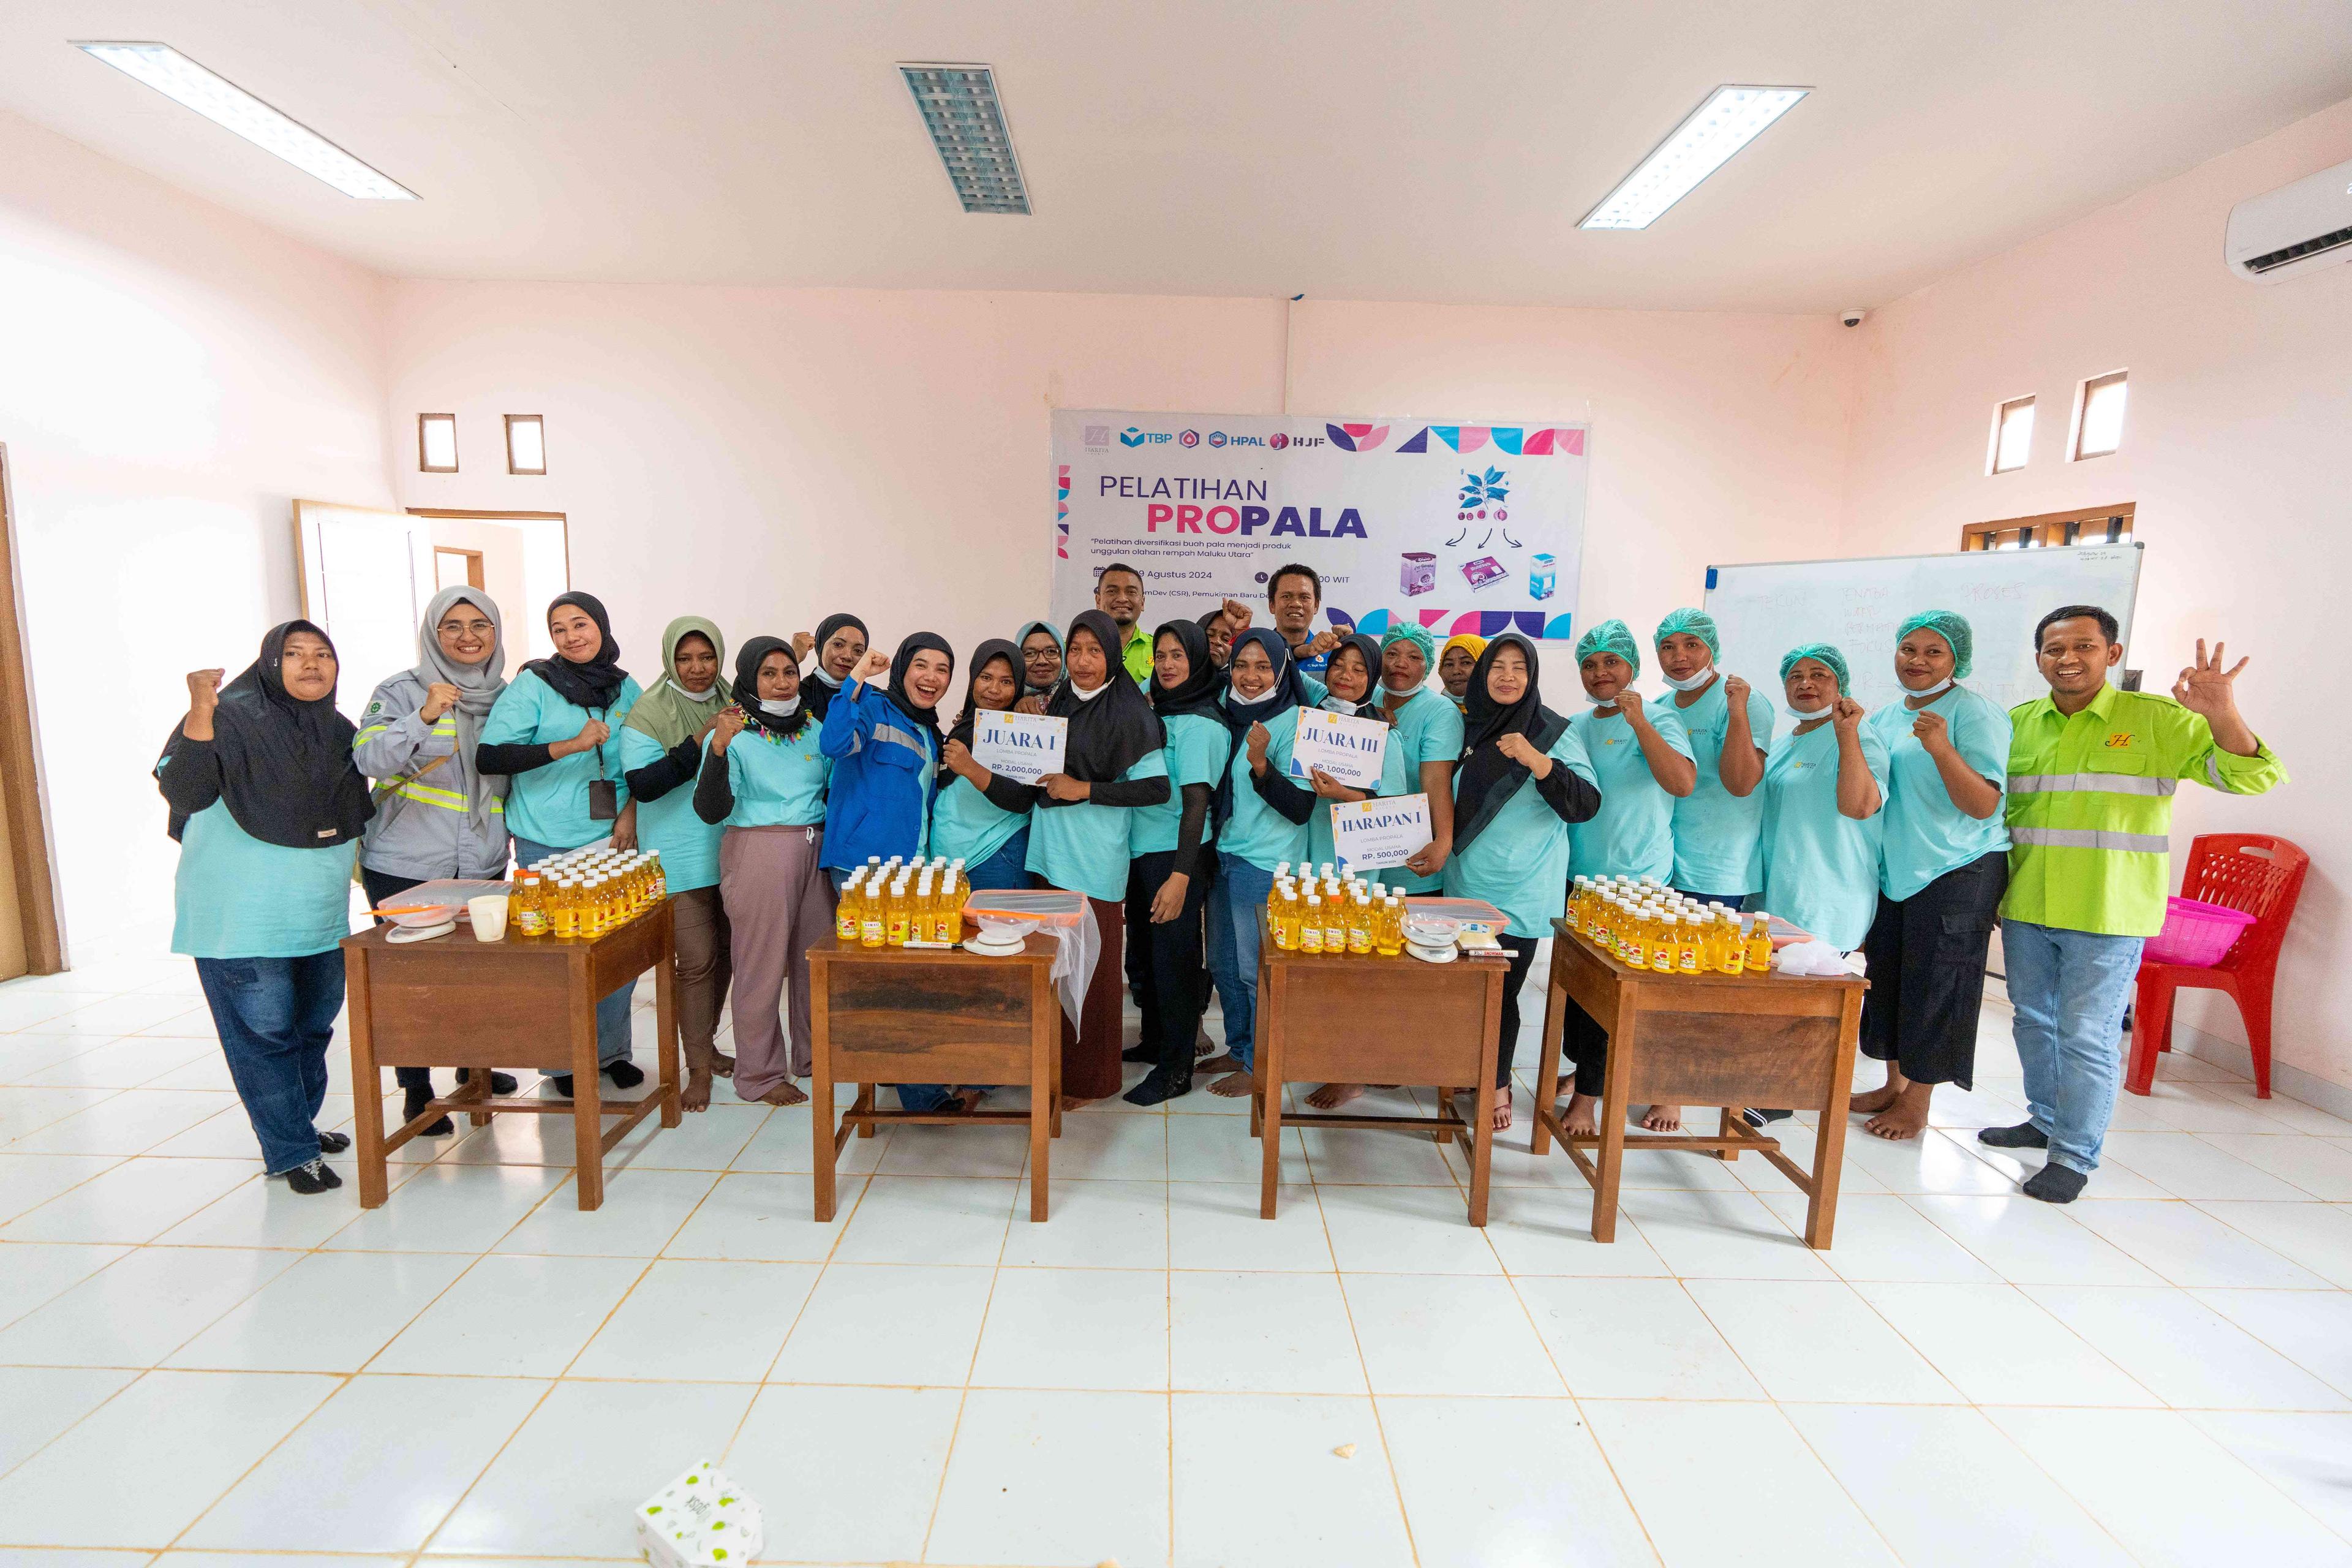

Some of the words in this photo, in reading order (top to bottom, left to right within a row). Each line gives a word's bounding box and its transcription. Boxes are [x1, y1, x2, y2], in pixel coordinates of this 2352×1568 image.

[1146, 433, 1173, 444] TBP
[1231, 436, 1266, 447] HPAL
[1293, 437, 1325, 447] HJF
[1100, 475, 1267, 501] PELATIHAN
[1147, 503, 1368, 538] PROPALA
[1147, 570, 1186, 579] Agustus
[982, 729, 1044, 750] JUARA
[1049, 736, 1056, 750] I
[1303, 728, 1355, 749] JUARA
[1361, 737, 1378, 753] III
[1005, 765, 1042, 775] 2,000,000
[1313, 763, 1325, 771] RP.
[1327, 766, 1362, 777] 1,000,000
[1342, 812, 1412, 832] HARAPAN
[1415, 812, 1422, 823] I
[1377, 849, 1409, 859] 500,000
